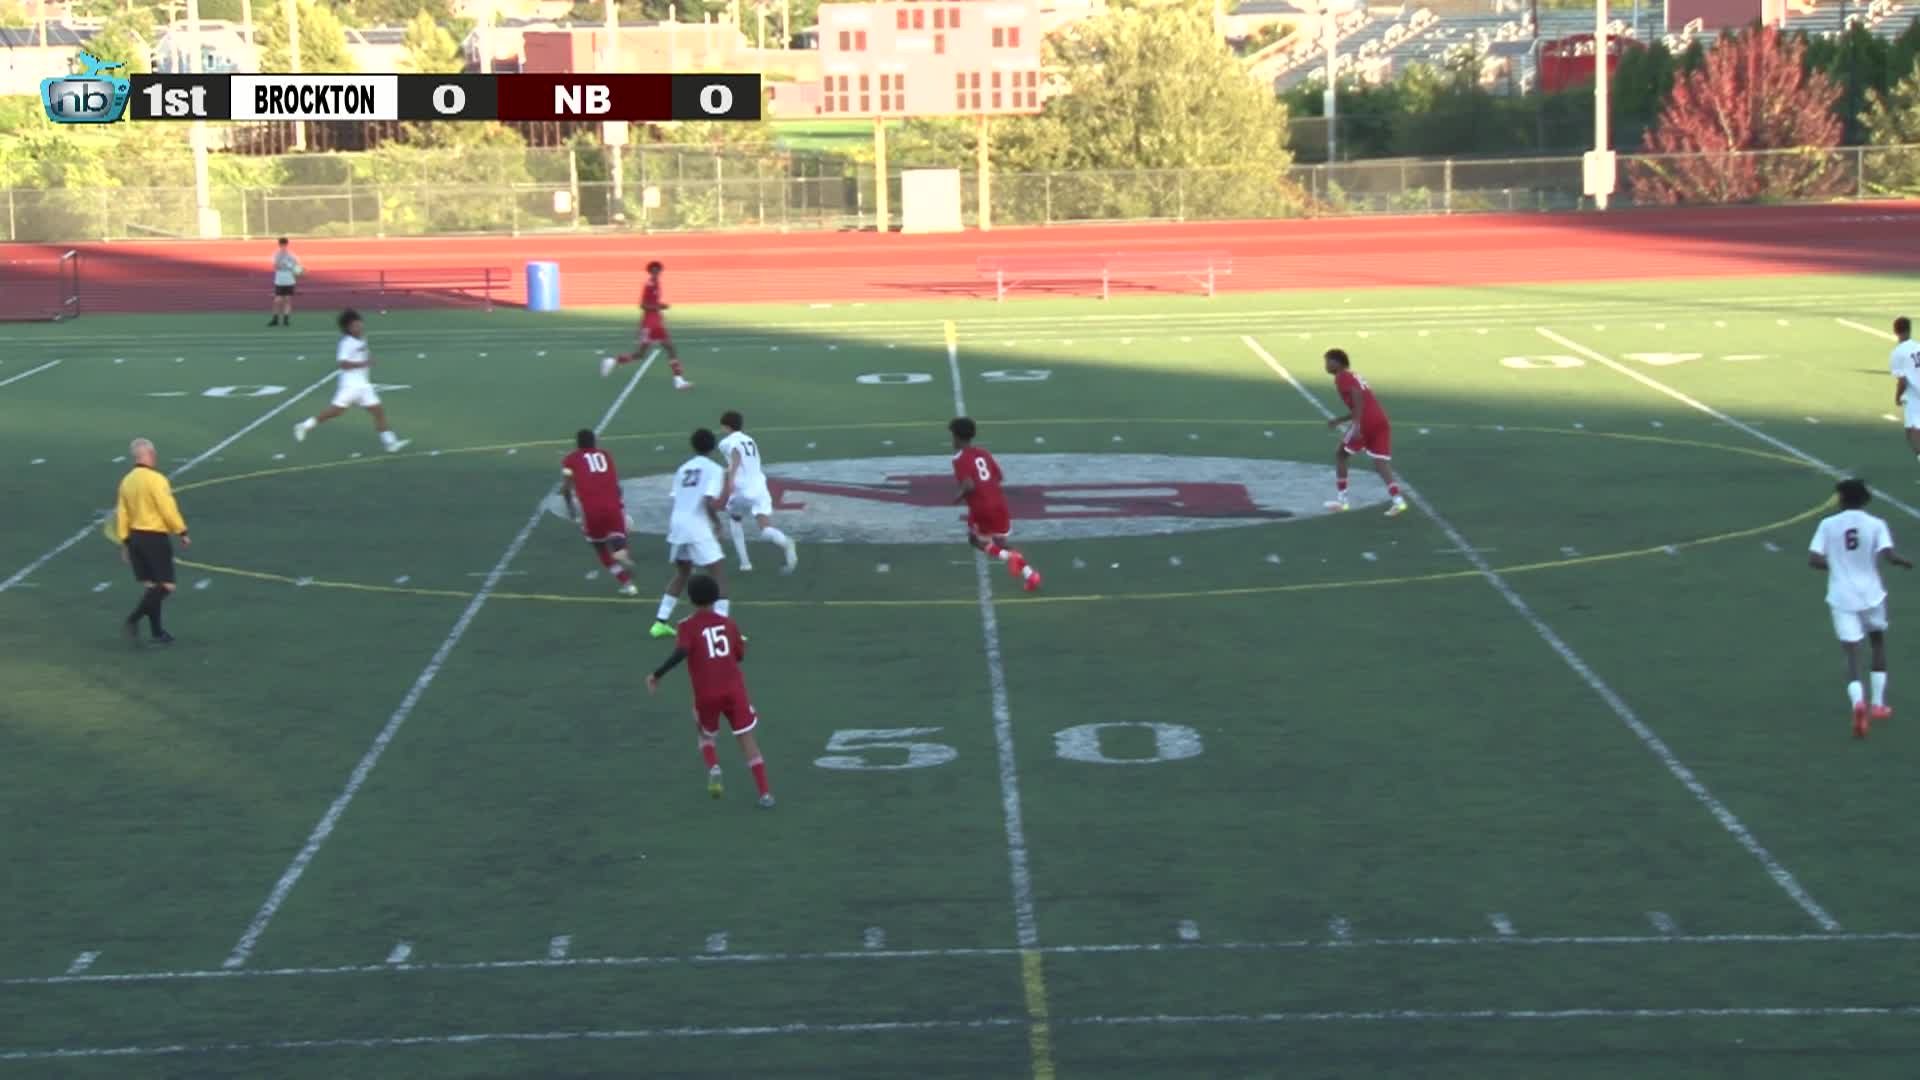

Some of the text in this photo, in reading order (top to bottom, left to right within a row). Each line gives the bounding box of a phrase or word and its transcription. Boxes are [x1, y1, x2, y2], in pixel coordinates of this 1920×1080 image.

[740, 440, 756, 457] 17
[583, 452, 608, 473] 10
[974, 456, 991, 481] 8
[1844, 528, 1859, 551] 6
[702, 624, 730, 658] 15
